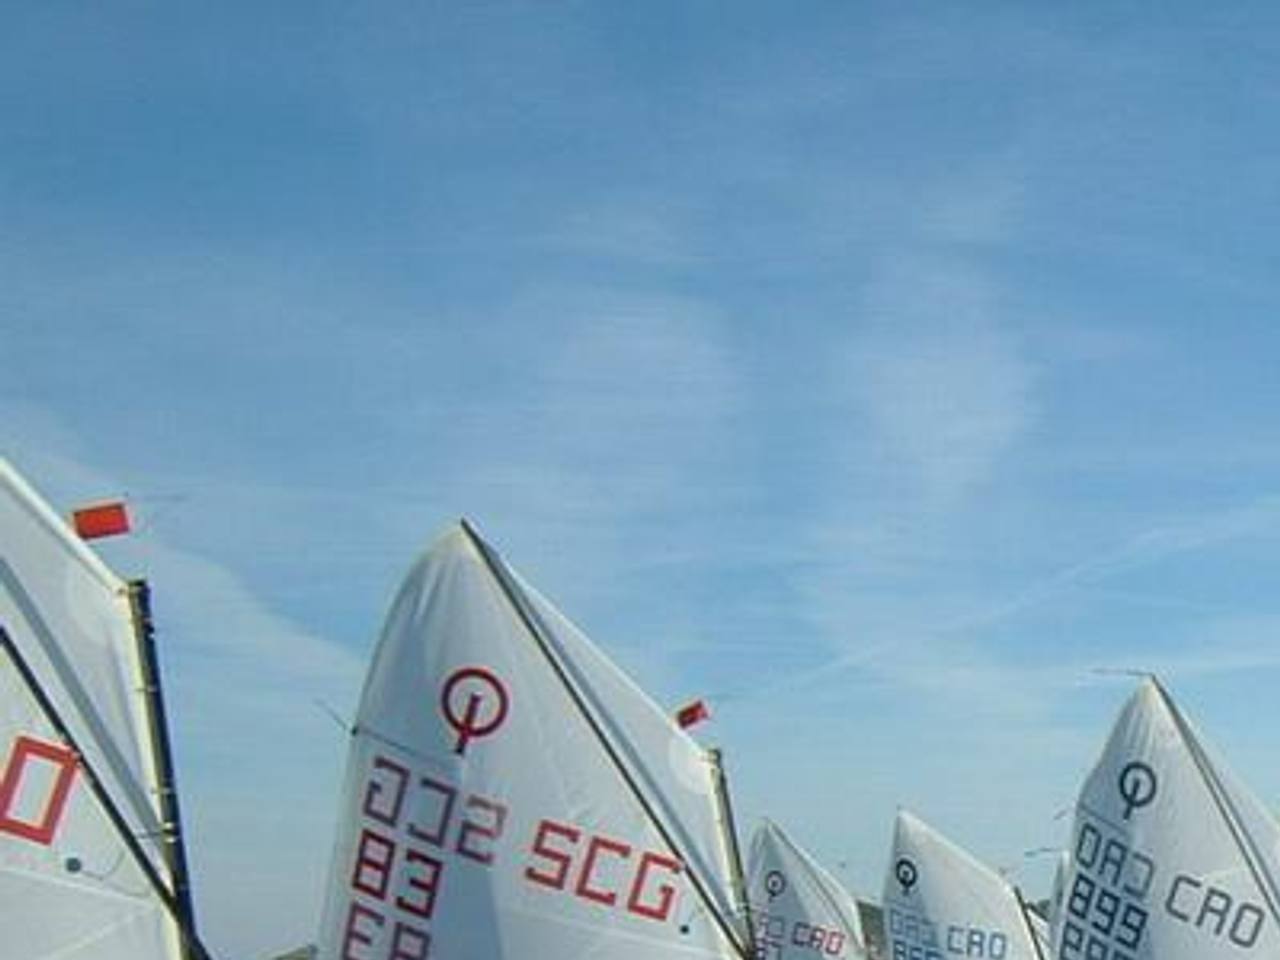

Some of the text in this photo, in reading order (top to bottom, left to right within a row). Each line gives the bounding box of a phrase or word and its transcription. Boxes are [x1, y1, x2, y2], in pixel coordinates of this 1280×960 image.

[352, 829, 443, 919] 83
[525, 820, 682, 921] SCG
[792, 921, 845, 955] CRO
[947, 925, 1006, 960] CRO
[1068, 873, 1149, 951] 899
[1165, 875, 1265, 948] CRO
